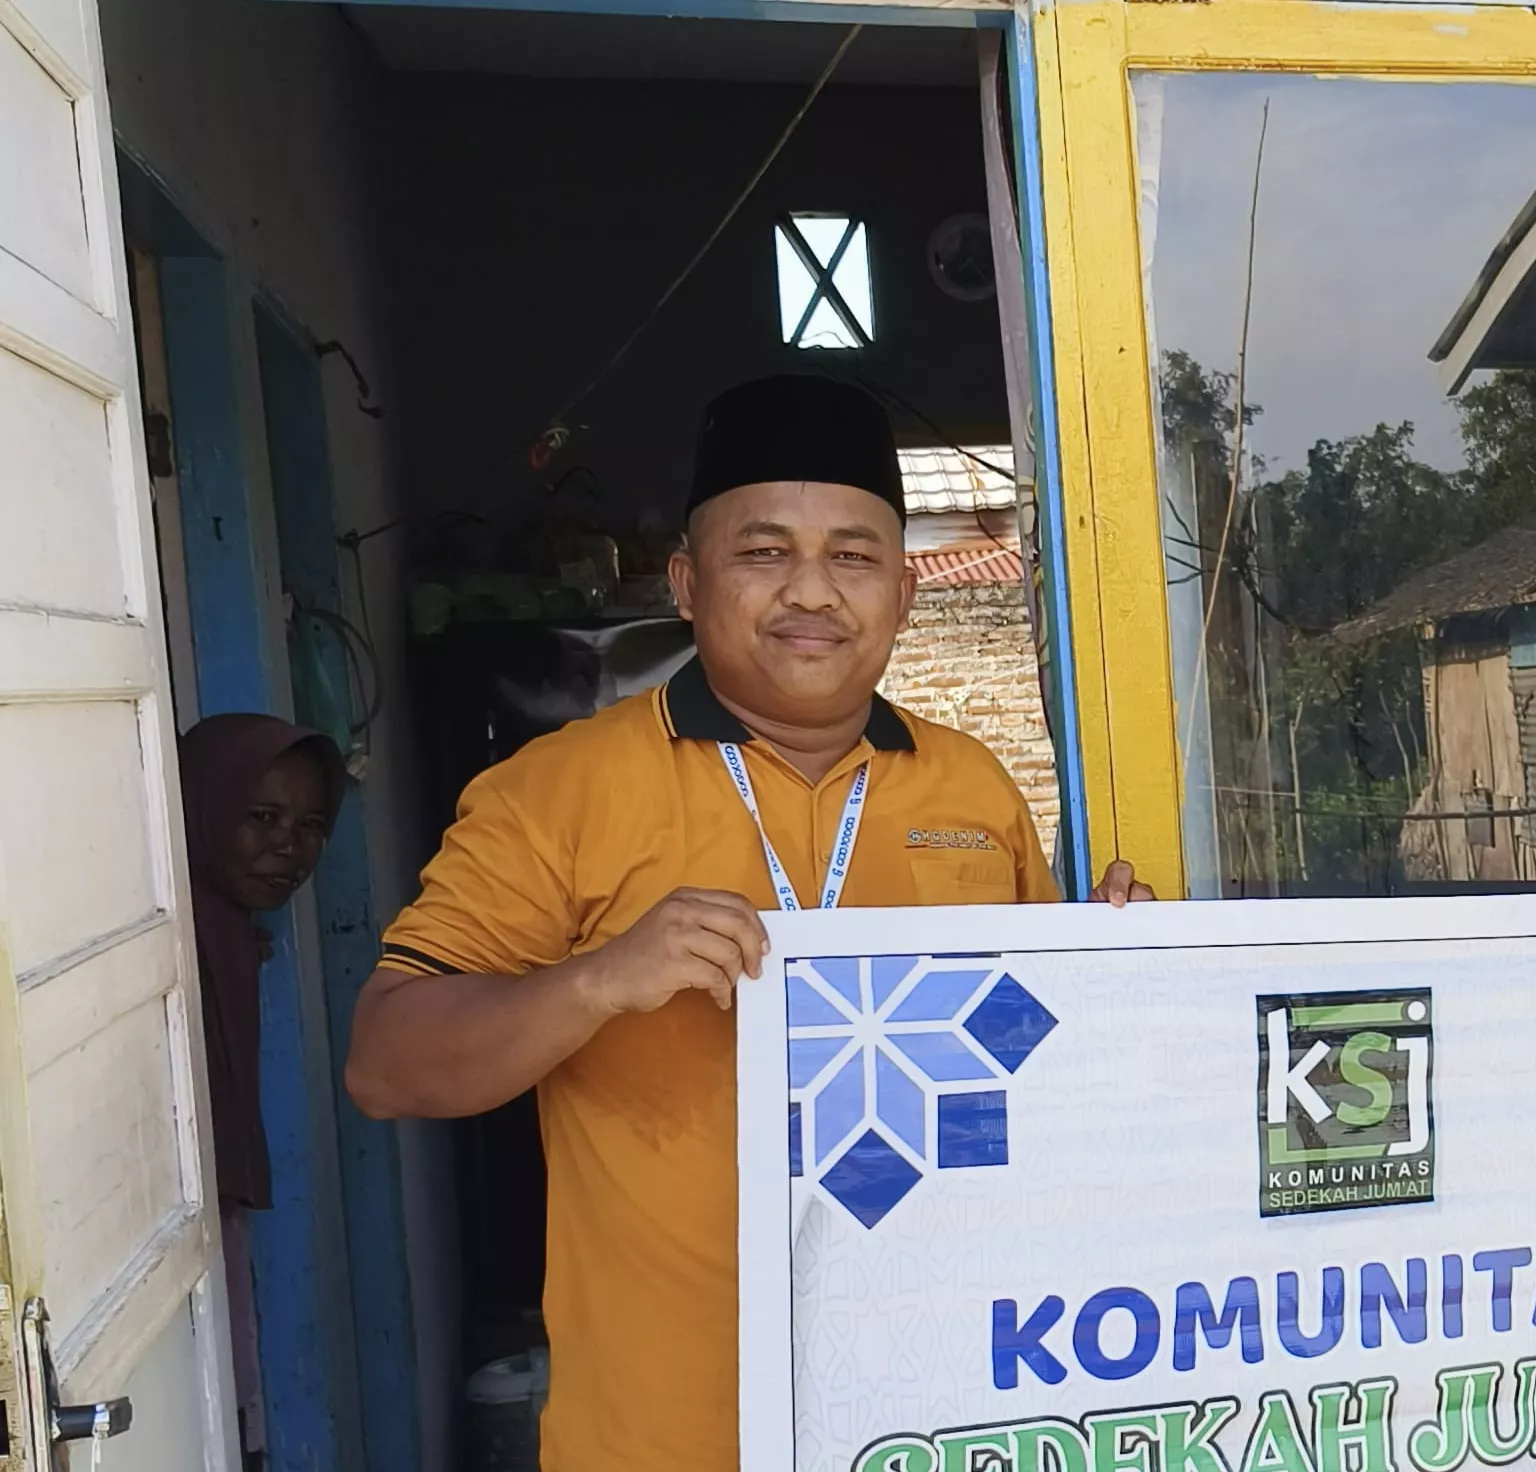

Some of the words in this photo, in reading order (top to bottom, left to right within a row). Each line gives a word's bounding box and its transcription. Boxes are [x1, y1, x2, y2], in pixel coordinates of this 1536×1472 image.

[1269, 1160, 1430, 1188] KOMUNITAS
[1269, 1185, 1359, 1209] SEDEKAH
[1363, 1179, 1429, 1199] JUM'AT
